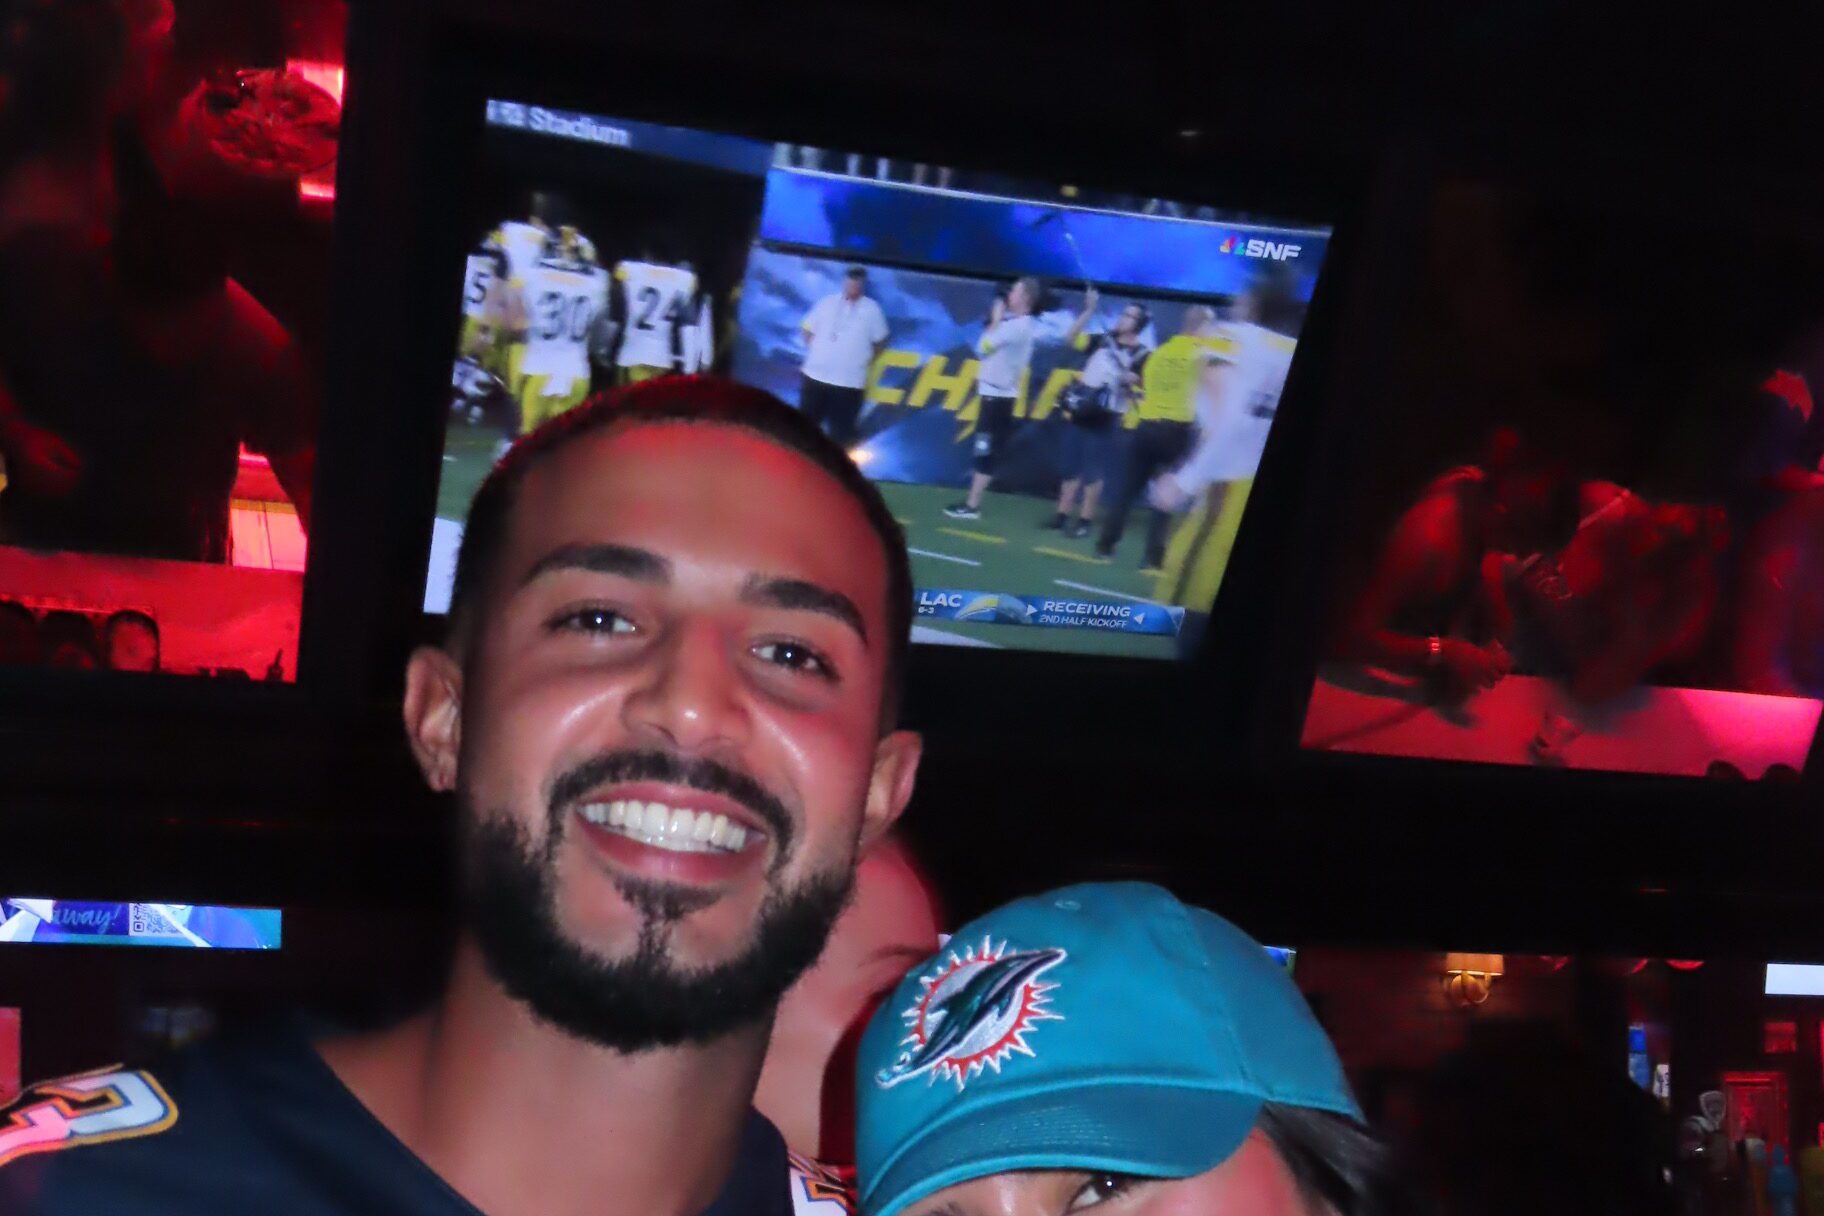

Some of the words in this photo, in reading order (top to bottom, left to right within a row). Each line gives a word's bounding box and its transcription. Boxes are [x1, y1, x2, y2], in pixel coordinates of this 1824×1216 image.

[529, 105, 629, 146] Stadium
[1245, 239, 1302, 261] SNF
[919, 592, 963, 608] LAC
[1043, 601, 1132, 618] RECEIVING
[1038, 614, 1061, 625] 2ND
[1062, 616, 1087, 627] HALF
[1087, 617, 1128, 629] KICKOFF
